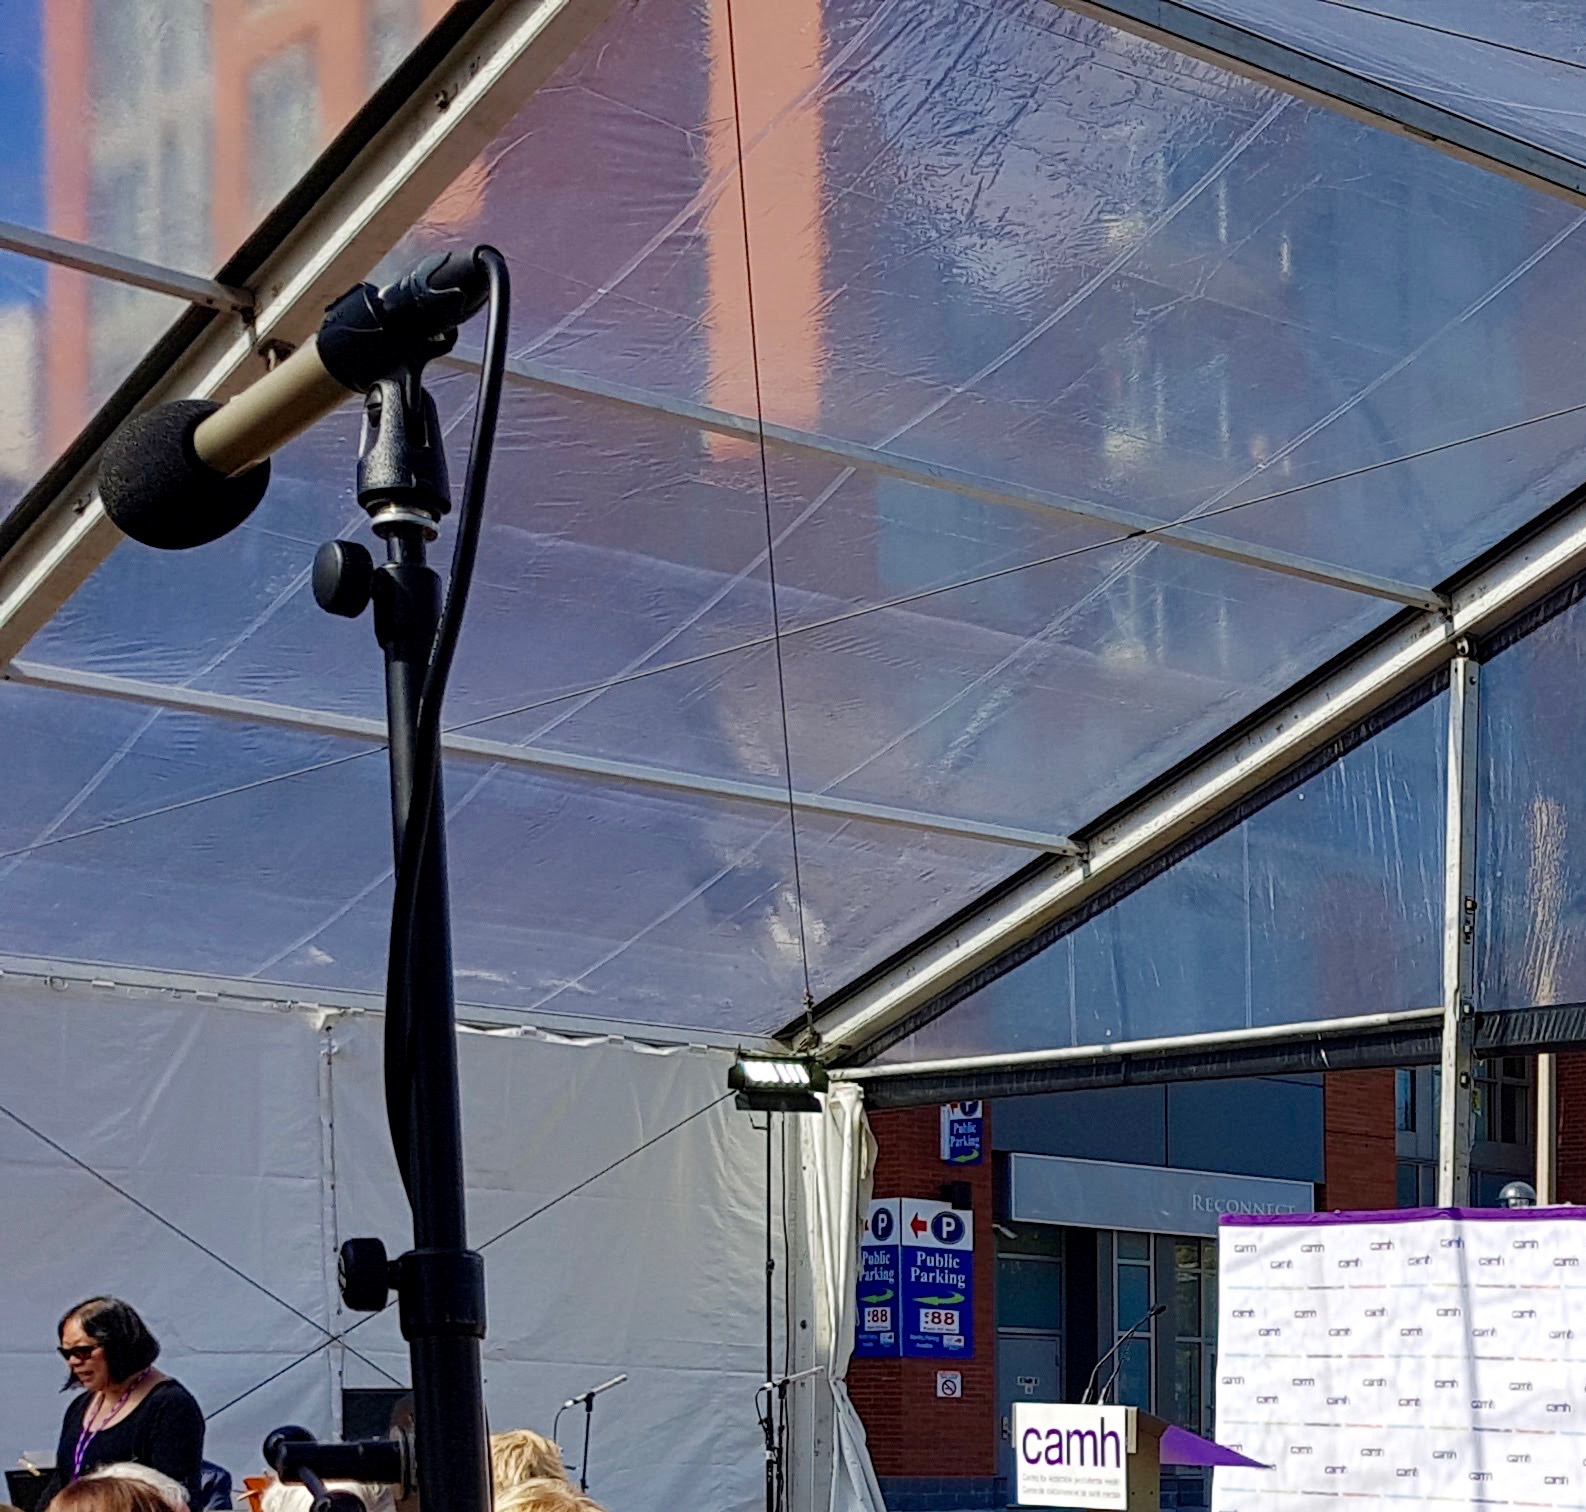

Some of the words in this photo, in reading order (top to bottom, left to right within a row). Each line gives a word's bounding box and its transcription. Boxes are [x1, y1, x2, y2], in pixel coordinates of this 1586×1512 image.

[955, 1121, 977, 1135] Public
[950, 1135, 980, 1149] Parking
[862, 1250, 891, 1266] Public
[916, 1251, 961, 1268] Public
[910, 1267, 966, 1289] Parking
[1022, 1417, 1121, 1468] camh
